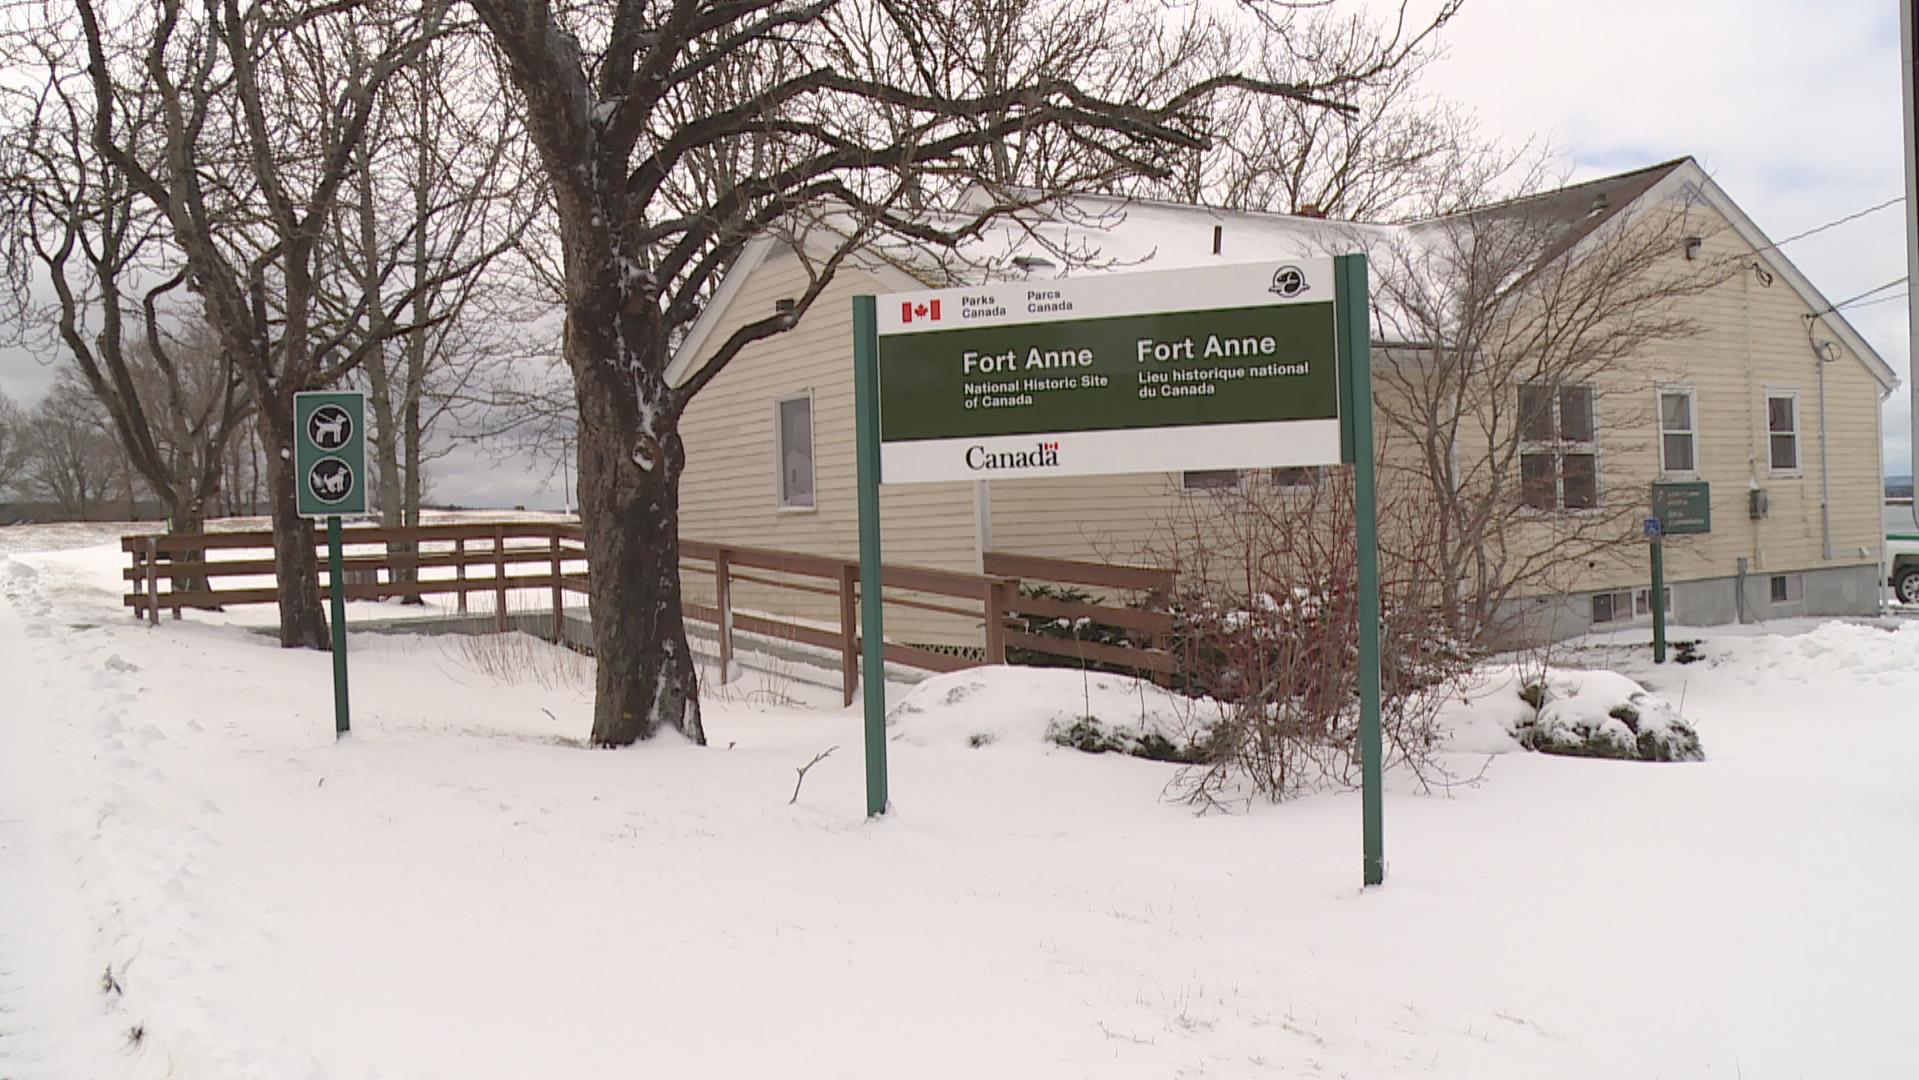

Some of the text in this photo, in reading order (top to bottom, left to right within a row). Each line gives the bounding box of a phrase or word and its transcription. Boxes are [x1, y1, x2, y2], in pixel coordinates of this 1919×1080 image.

[962, 295, 995, 306] Parks
[1027, 290, 1061, 301] Parcs
[962, 306, 1006, 319] Canada
[1027, 300, 1073, 313] Canada
[1137, 335, 1276, 362] Fort Anne
[963, 347, 1093, 374] Fort Anne
[1138, 361, 1310, 384] Lieu historique national
[964, 374, 1108, 395] National Historic Site
[1138, 382, 1215, 398] du Canada
[964, 393, 1033, 409] of Canada
[965, 442, 1059, 471] Canada
